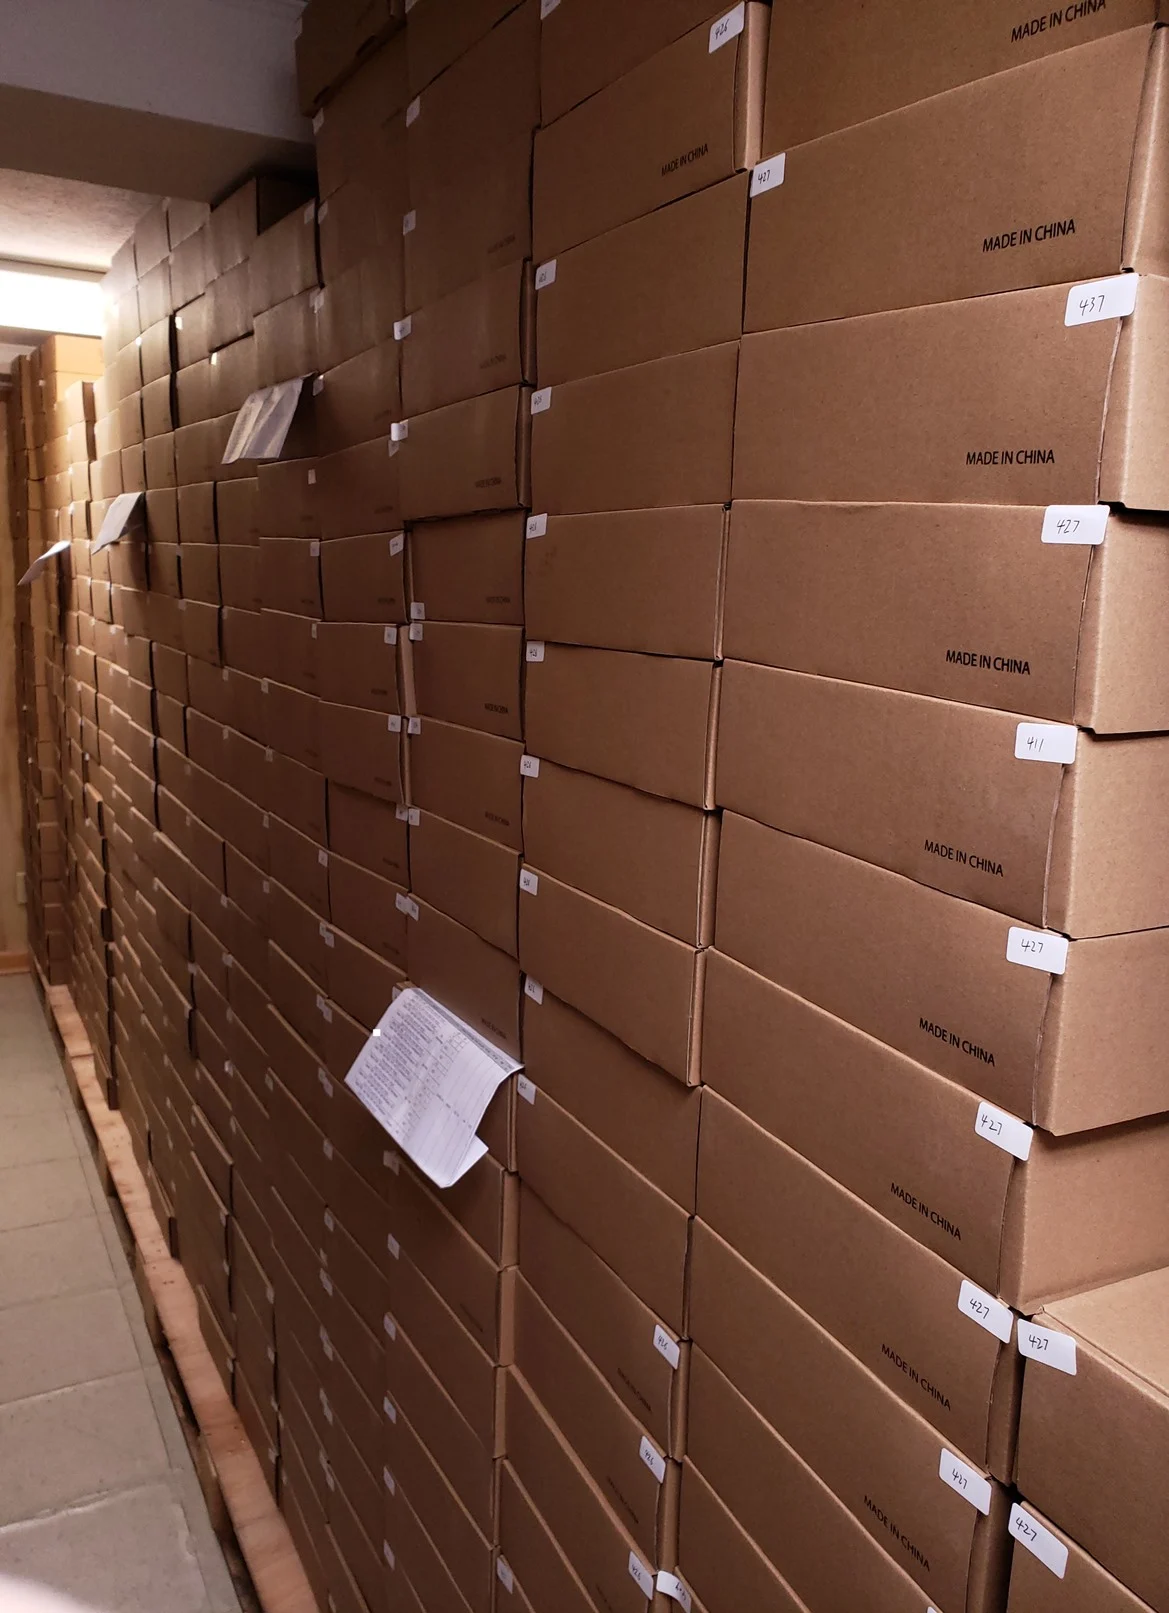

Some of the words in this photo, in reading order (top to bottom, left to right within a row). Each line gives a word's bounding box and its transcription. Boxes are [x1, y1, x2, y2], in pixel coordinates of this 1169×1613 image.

[1010, 15, 1047, 43] MADE
[1049, 10, 1063, 28] IN
[1065, 0, 1106, 22] CHINA
[661, 158, 679, 177] MADE
[680, 154, 687, 167] IN
[687, 143, 709, 162] CHINA
[757, 169, 771, 186] 427
[982, 232, 1018, 253] MADE
[1019, 228, 1032, 245] IN
[1035, 218, 1075, 242] CHINA
[1079, 294, 1106, 316] 437
[965, 450, 1000, 465] MADE
[1001, 449, 1014, 465] IN
[1016, 448, 1055, 465] CHINA
[1056, 519, 1080, 534] 427
[945, 649, 978, 667] MADE
[979, 654, 991, 670] IN
[993, 656, 1031, 676] CHINA
[924, 839, 954, 860] MADE
[956, 849, 967, 865] IN
[969, 855, 1004, 878] CHINA
[1020, 938, 1044, 954] 427
[919, 1017, 948, 1042] MADE
[949, 1032, 960, 1049] IN
[961, 1040, 995, 1067] CHINA
[979, 1114, 1003, 1136] 427
[890, 1182, 918, 1210] MADE
[919, 1201, 929, 1218] IN
[930, 1211, 962, 1241] CHINA
[969, 1297, 990, 1320] 427
[1028, 1333, 1049, 1351] 427
[881, 1343, 908, 1374] MADE
[909, 1366, 919, 1384] IN
[920, 1378, 952, 1412] CHINA
[952, 1467, 968, 1490] 427
[863, 1495, 889, 1529] MADE
[890, 1522, 900, 1540] IN
[900, 1535, 930, 1572] CHINA
[1014, 1517, 1038, 1542] 427
